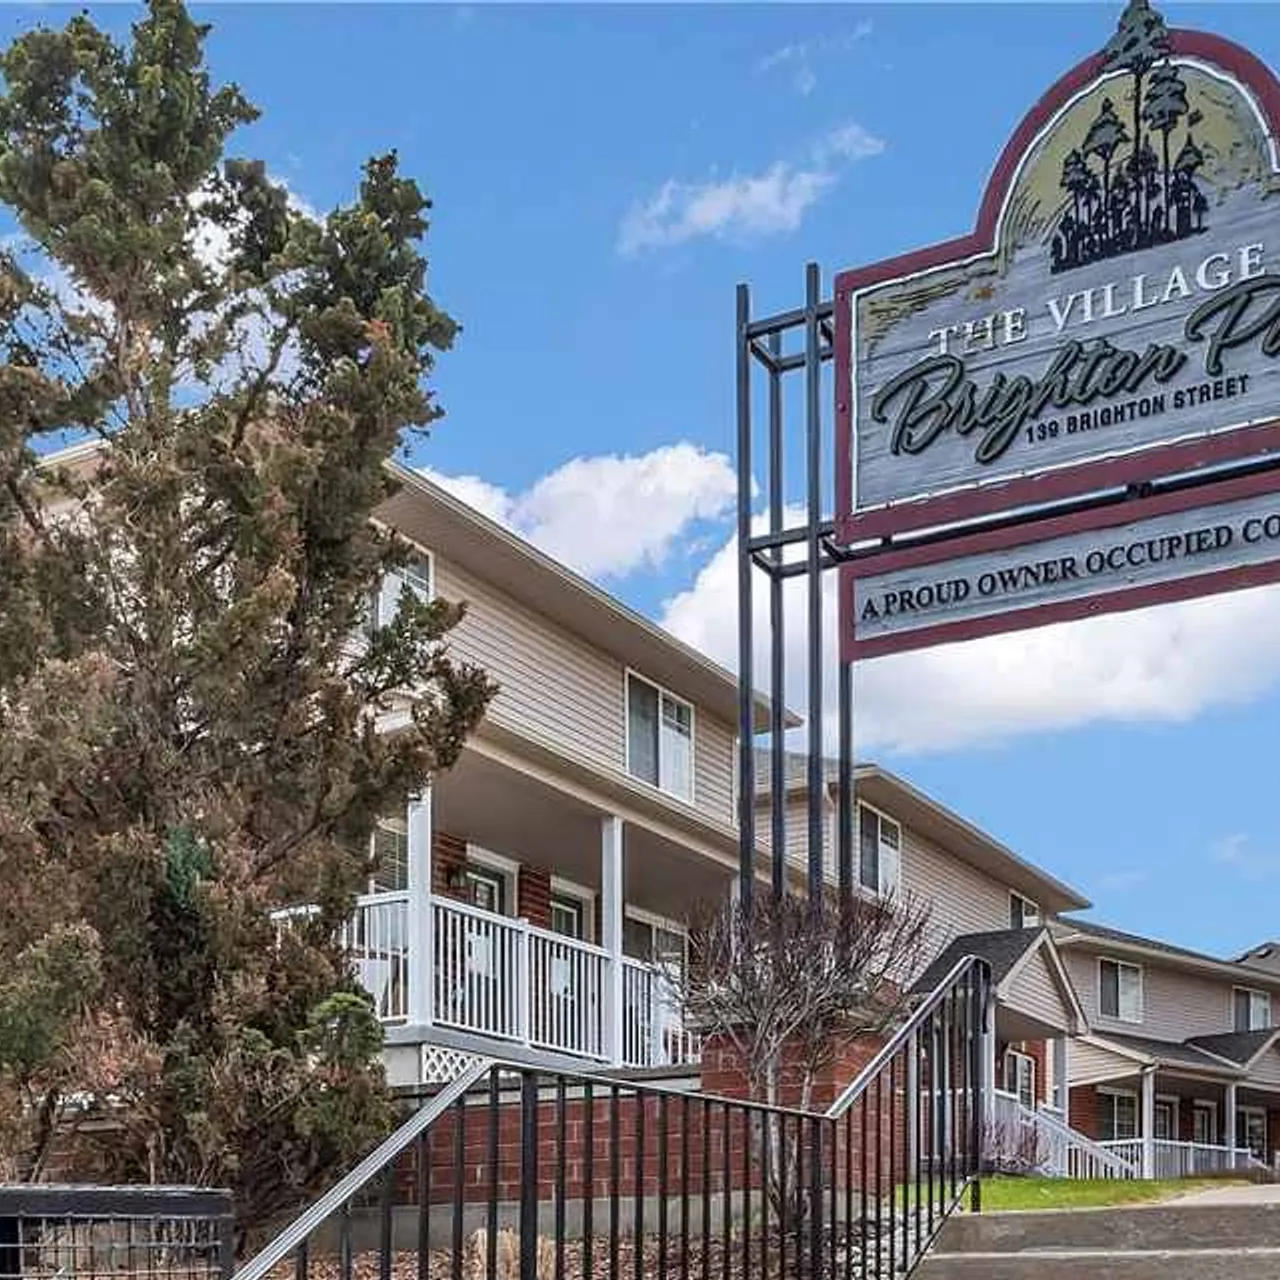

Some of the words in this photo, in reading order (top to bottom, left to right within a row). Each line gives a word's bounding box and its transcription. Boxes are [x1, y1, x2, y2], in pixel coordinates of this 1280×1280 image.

[927, 306, 1028, 355] THE
[1045, 242, 1267, 332] VILLAGE
[870, 337, 1188, 465] Brighton
[1025, 419, 1060, 444] 139
[1066, 395, 1166, 434] BRIGHTON
[1173, 373, 1250, 410] STREET
[861, 597, 880, 621] A
[882, 578, 971, 612] PROUD
[977, 556, 1079, 597] OWNER
[1085, 525, 1233, 574] OCCUPIED
